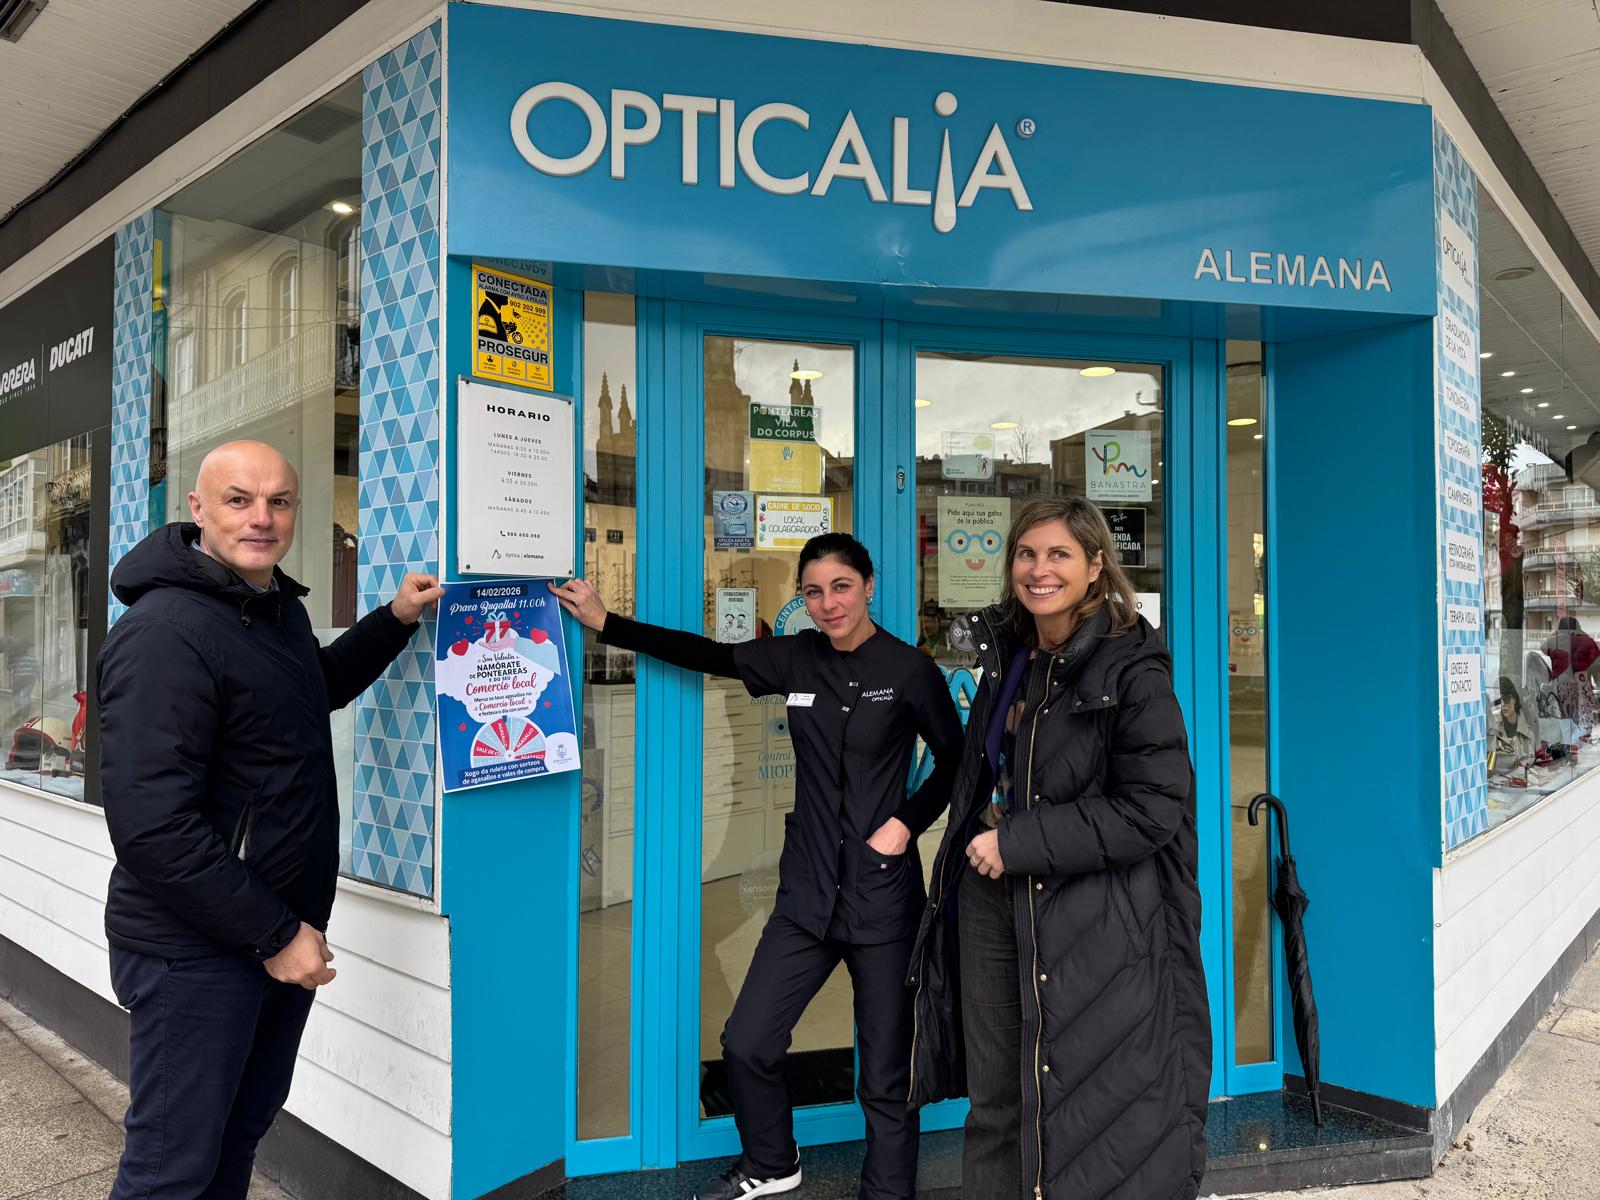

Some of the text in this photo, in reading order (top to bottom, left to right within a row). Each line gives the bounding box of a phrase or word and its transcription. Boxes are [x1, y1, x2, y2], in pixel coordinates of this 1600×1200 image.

[1194, 248, 1392, 292] ALEMANA
[478, 273, 548, 299] CONECTADA
[49, 326, 94, 372] DUCATI
[478, 339, 548, 364] PROSEGUR
[487, 404, 551, 422] HORARIO
[753, 406, 819, 418] PONTEAREAS
[774, 419, 798, 428] VILA
[493, 432, 513, 440] LUNES
[520, 436, 542, 445] JUEVES
[757, 428, 815, 439] DO CORPUS
[507, 470, 532, 479] VIERNES
[1090, 481, 1146, 489] BANASTRA
[504, 496, 533, 504] SÁBADOS
[768, 525, 820, 534] COLABORADOR
[1116, 542, 1141, 551] FICADA
[476, 586, 521, 597] 14/02/2026
[450, 603, 478, 615] Praza
[480, 599, 516, 615] Bugallal
[775, 597, 806, 629] CENTRO
[477, 660, 521, 671] NAMÓRATE
[476, 667, 528, 679] PONTEAREAS
[465, 672, 537, 696] Comercio local
[861, 688, 894, 698] ALEMANA
[479, 697, 526, 711] Comercio local
[758, 751, 792, 762] Control
[465, 770, 480, 778] Xogo
[489, 766, 508, 774] ruleta
[519, 759, 541, 769] sorteos
